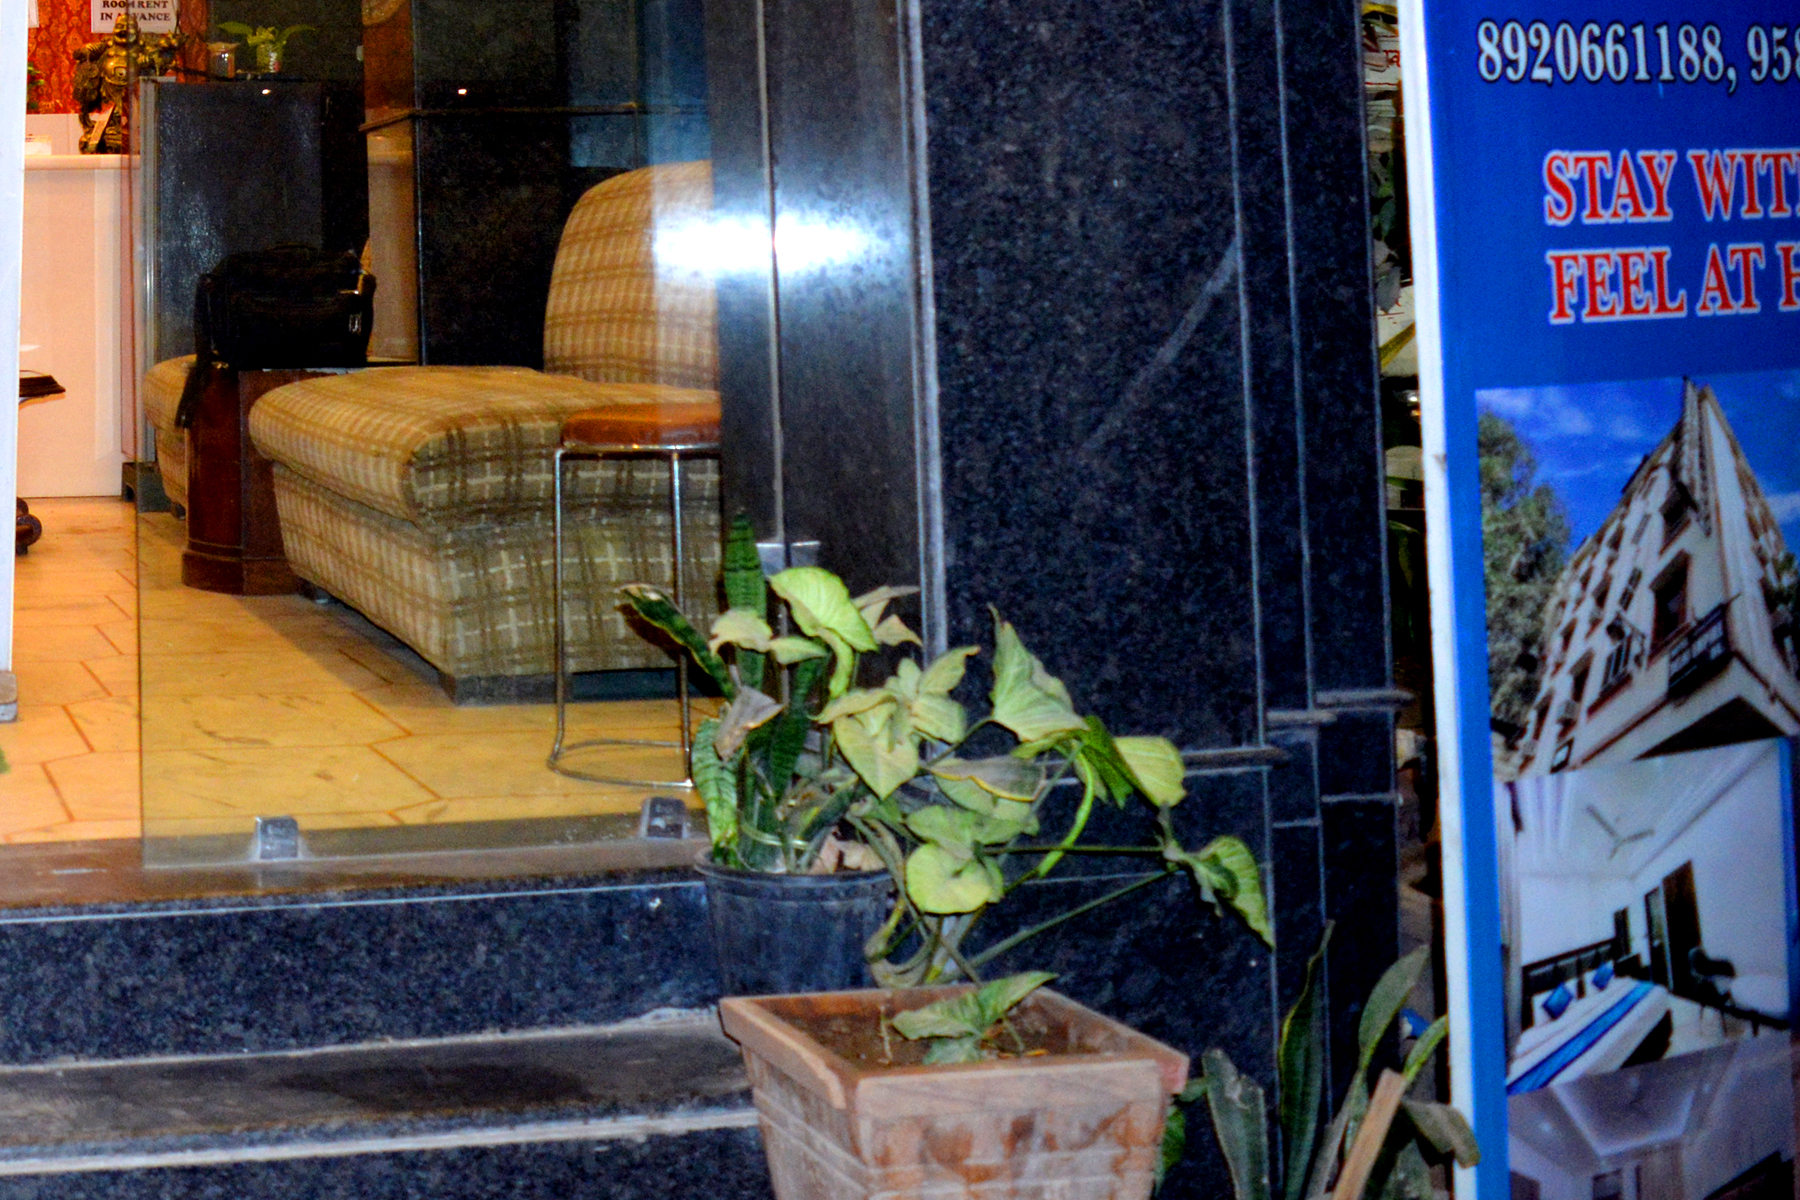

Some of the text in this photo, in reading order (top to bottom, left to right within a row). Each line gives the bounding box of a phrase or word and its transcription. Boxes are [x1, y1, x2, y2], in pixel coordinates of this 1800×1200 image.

[137, 0, 168, 8] RENT
[1477, 20, 1738, 94] 8920661188,
[1543, 148, 1800, 227] STAY WIT
[1546, 246, 1687, 325] FEEL
[1696, 243, 1765, 317] AT
